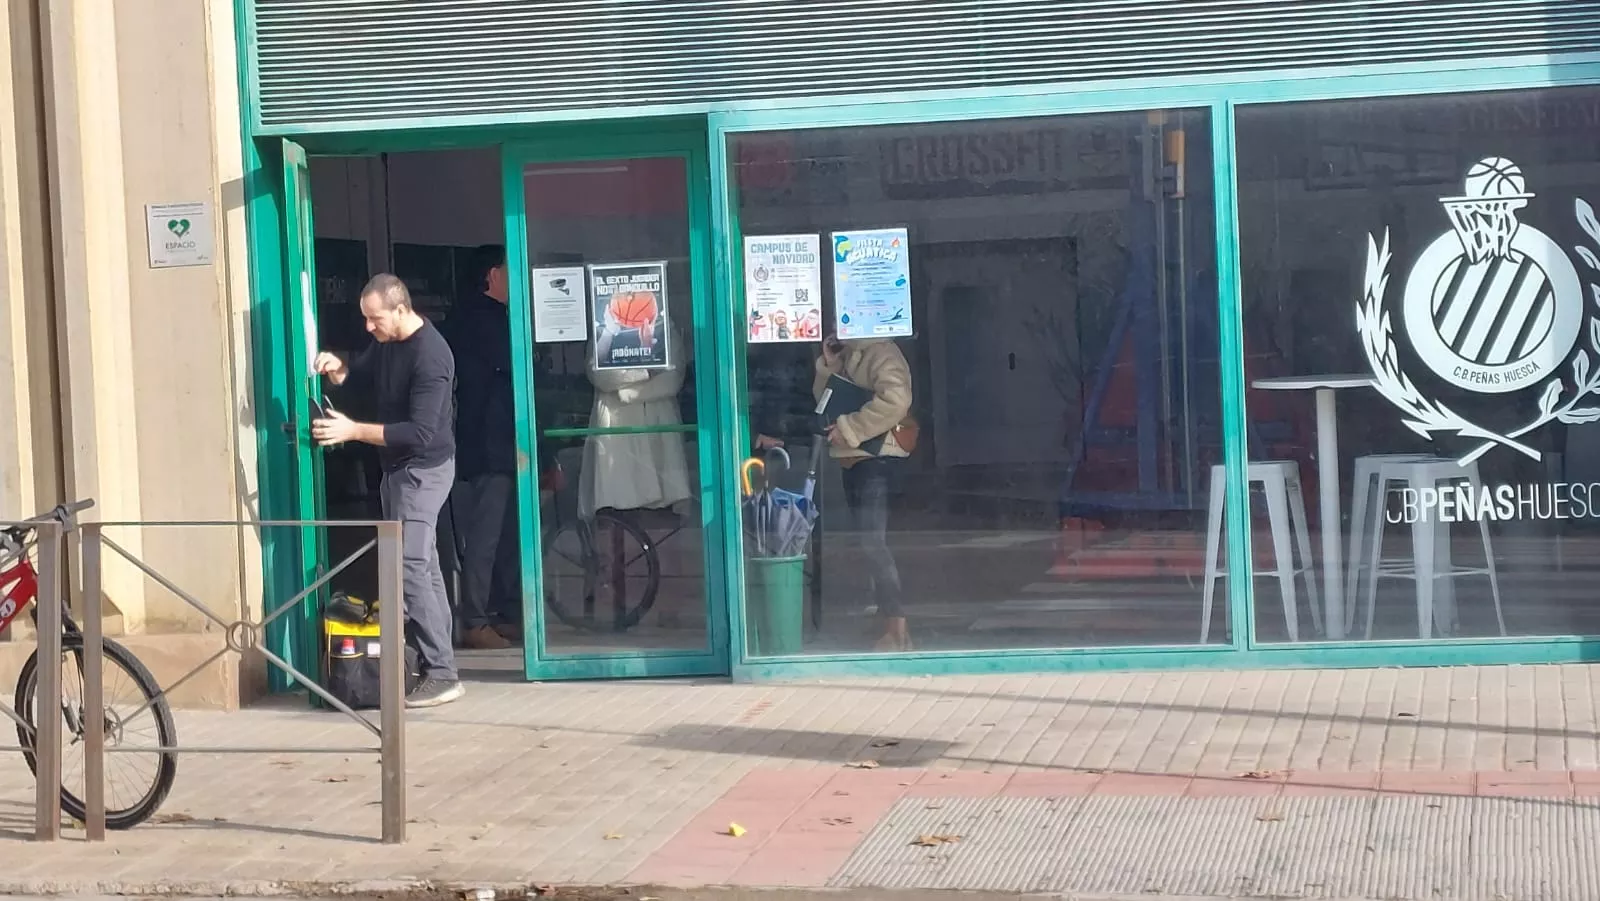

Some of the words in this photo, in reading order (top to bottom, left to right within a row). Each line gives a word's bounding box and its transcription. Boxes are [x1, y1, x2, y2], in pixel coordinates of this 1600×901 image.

[889, 128, 1068, 181] CROSSFIT
[165, 240, 197, 250] ESPACIO
[750, 241, 792, 254] CAMPUS
[794, 241, 809, 253] DE
[772, 252, 816, 265] NAVIDAD
[1503, 360, 1541, 383] HUESCA
